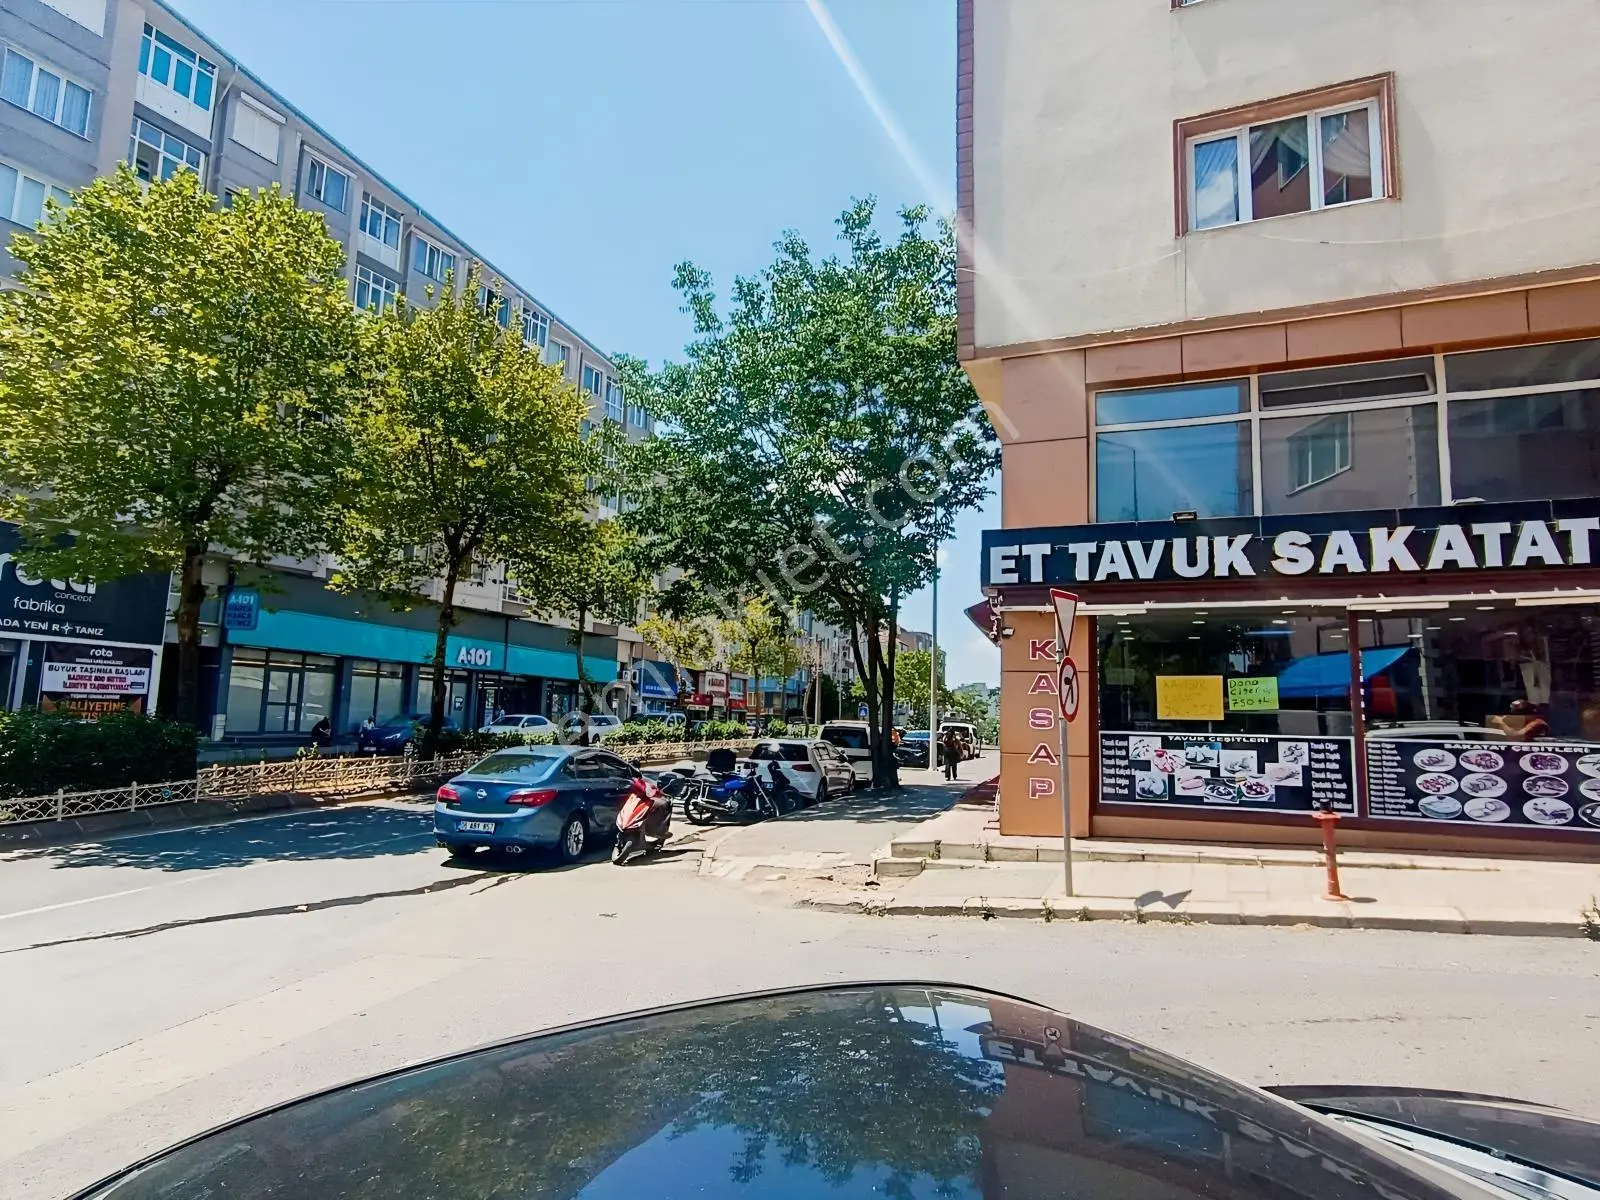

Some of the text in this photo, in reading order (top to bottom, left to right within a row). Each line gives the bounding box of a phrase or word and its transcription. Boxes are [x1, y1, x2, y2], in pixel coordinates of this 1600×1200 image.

[989, 517, 1599, 583] ET TAVUK SAKATAT
[54, 591, 92, 602] concept
[13, 596, 65, 614] fabrika
[24, 620, 49, 630] YENİ
[90, 648, 113, 657] rota
[1027, 639, 1059, 799] KASAP
[1444, 743, 1507, 751] SAKATAT
